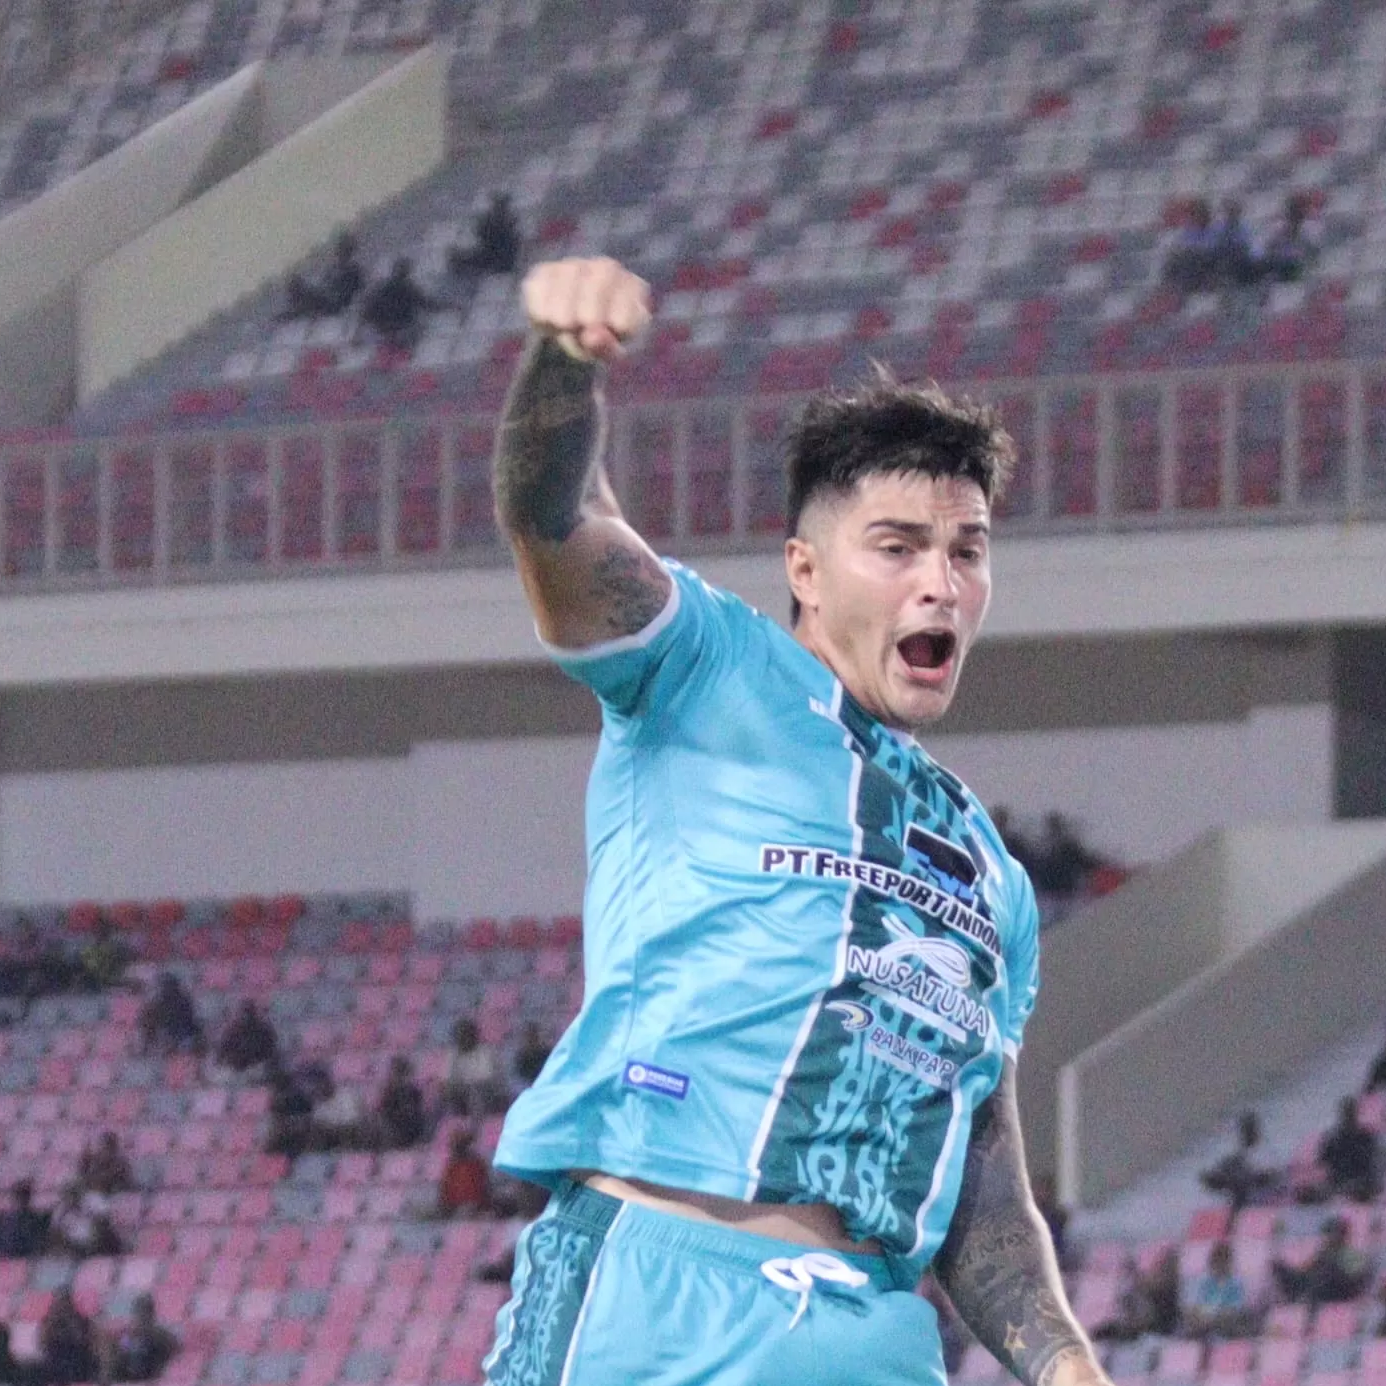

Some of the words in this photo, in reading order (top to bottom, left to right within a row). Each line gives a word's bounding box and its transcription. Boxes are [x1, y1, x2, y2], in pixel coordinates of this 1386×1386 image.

[762, 846, 810, 875] PT
[849, 948, 989, 1038] NUSATUNA
[870, 1027, 916, 1062] BANK
[915, 1050, 955, 1078] PAP
